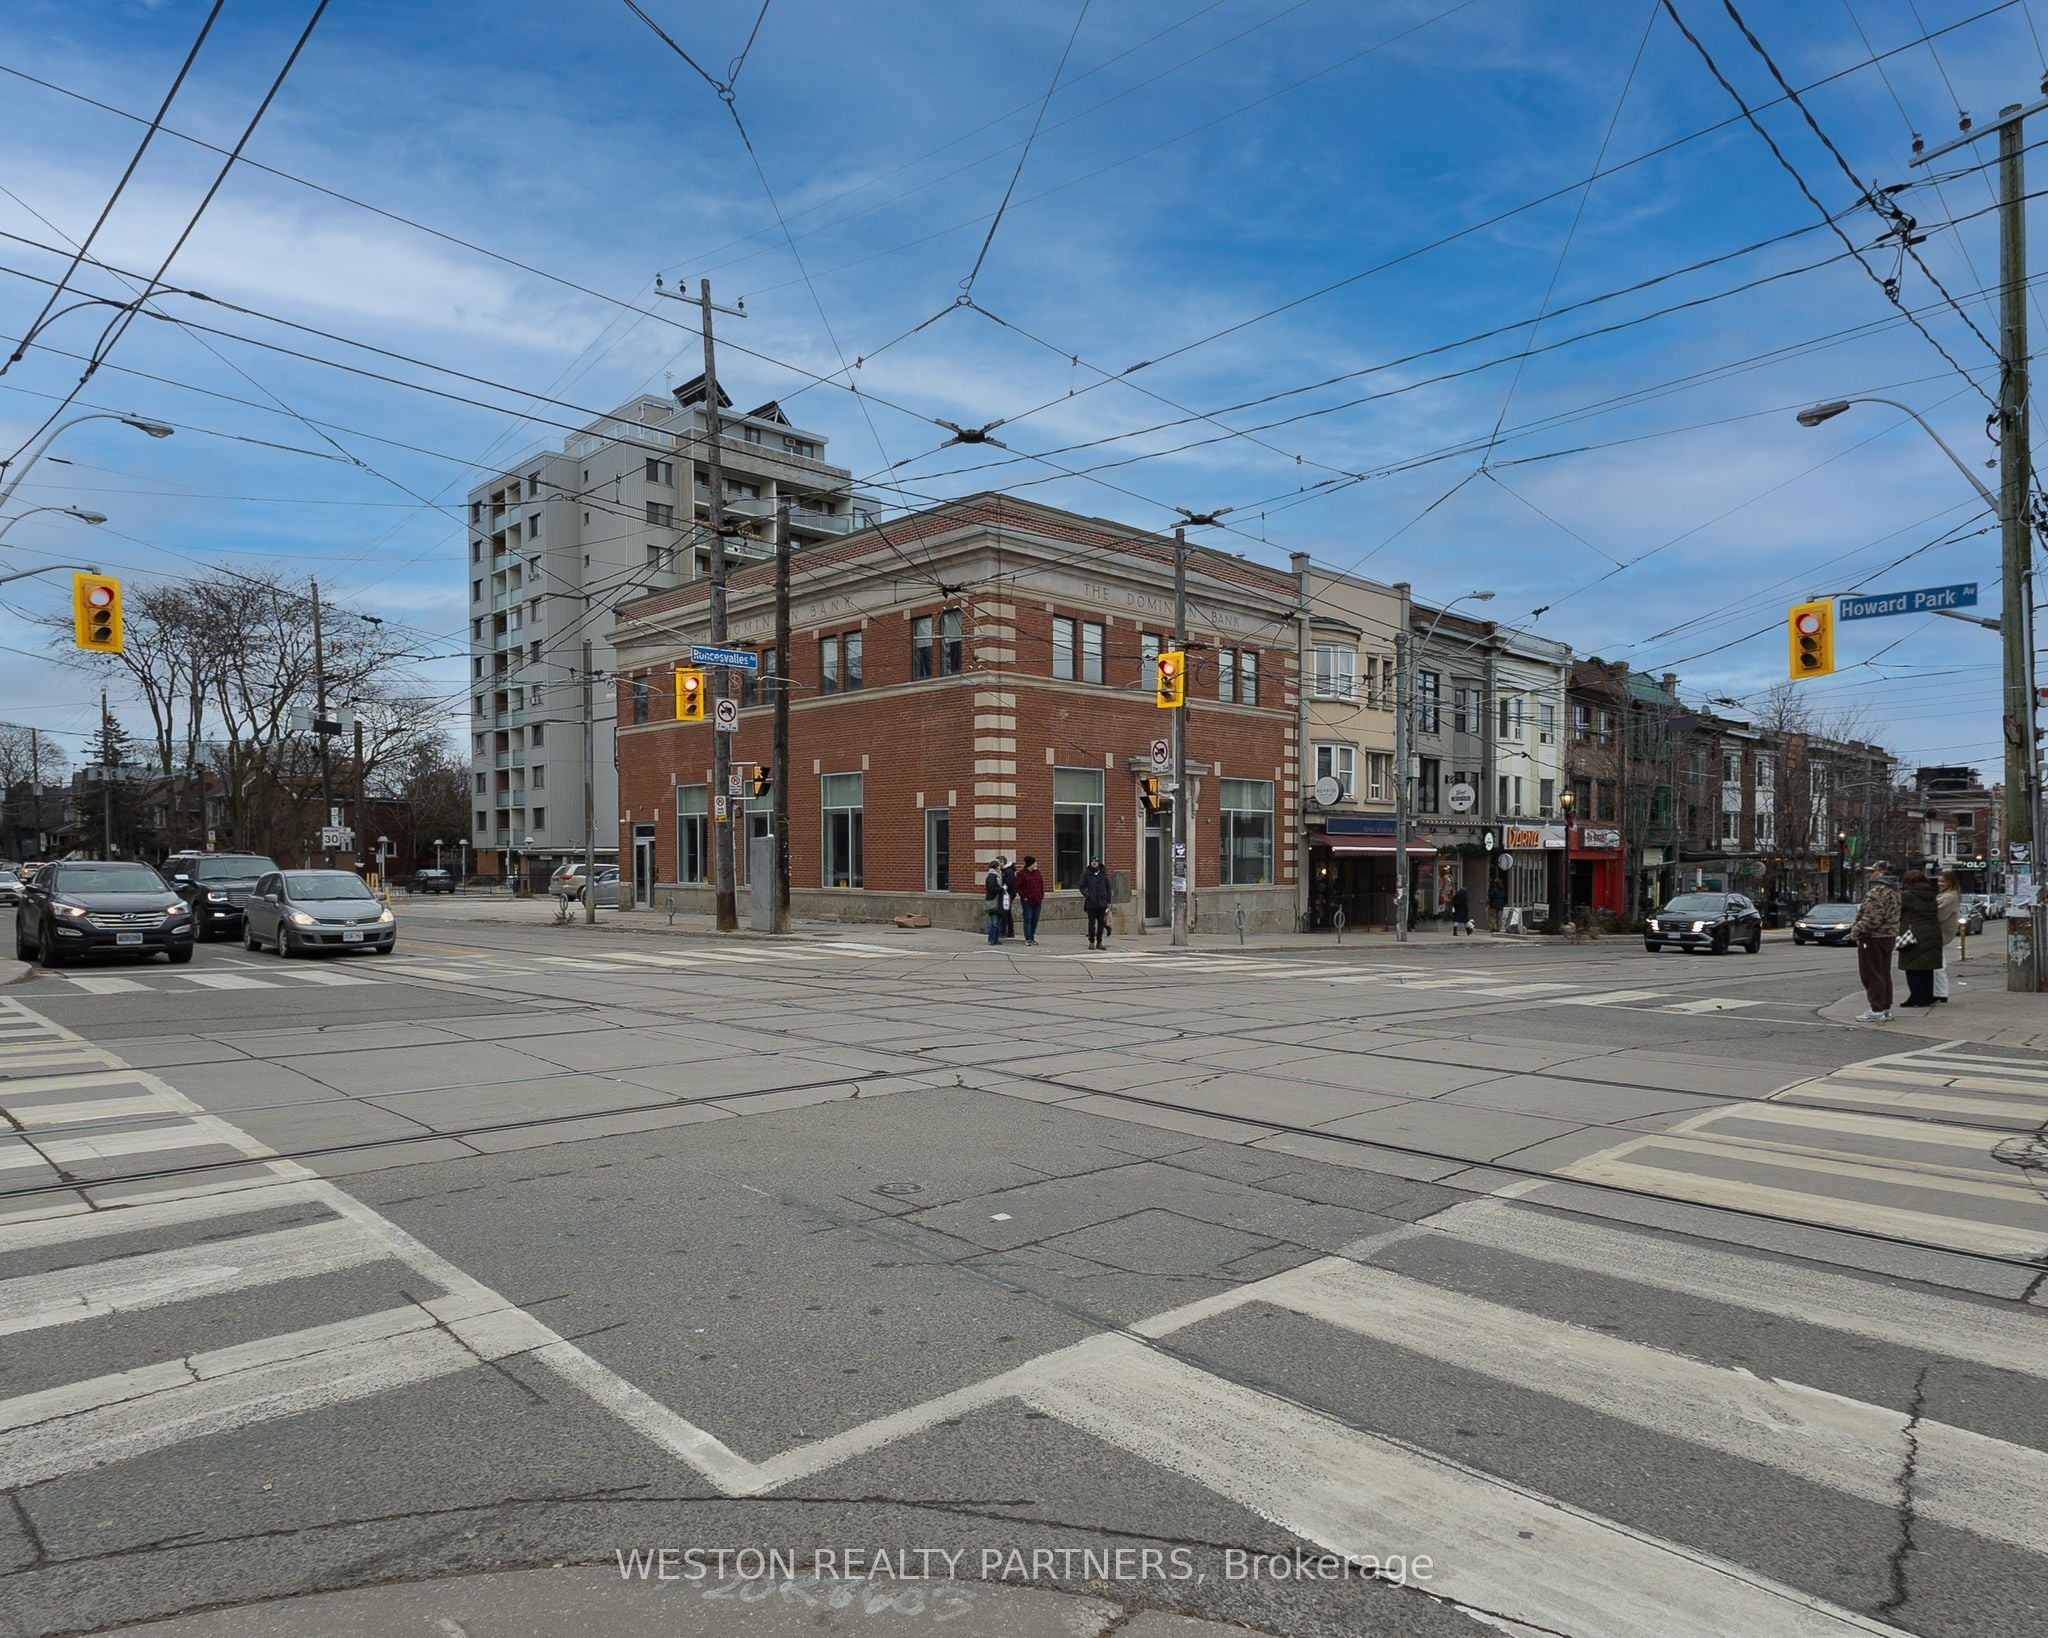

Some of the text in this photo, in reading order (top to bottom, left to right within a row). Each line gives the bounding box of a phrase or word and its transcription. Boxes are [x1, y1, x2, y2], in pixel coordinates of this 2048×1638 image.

[809, 596, 852, 618] BANK
[1083, 583, 1241, 629] THE DOMINN BANK
[1841, 586, 1976, 618] Howard Park Av
[693, 648, 749, 665] Roncesvalles
[324, 834, 339, 844] 30
[1507, 827, 1540, 848] DARNA
